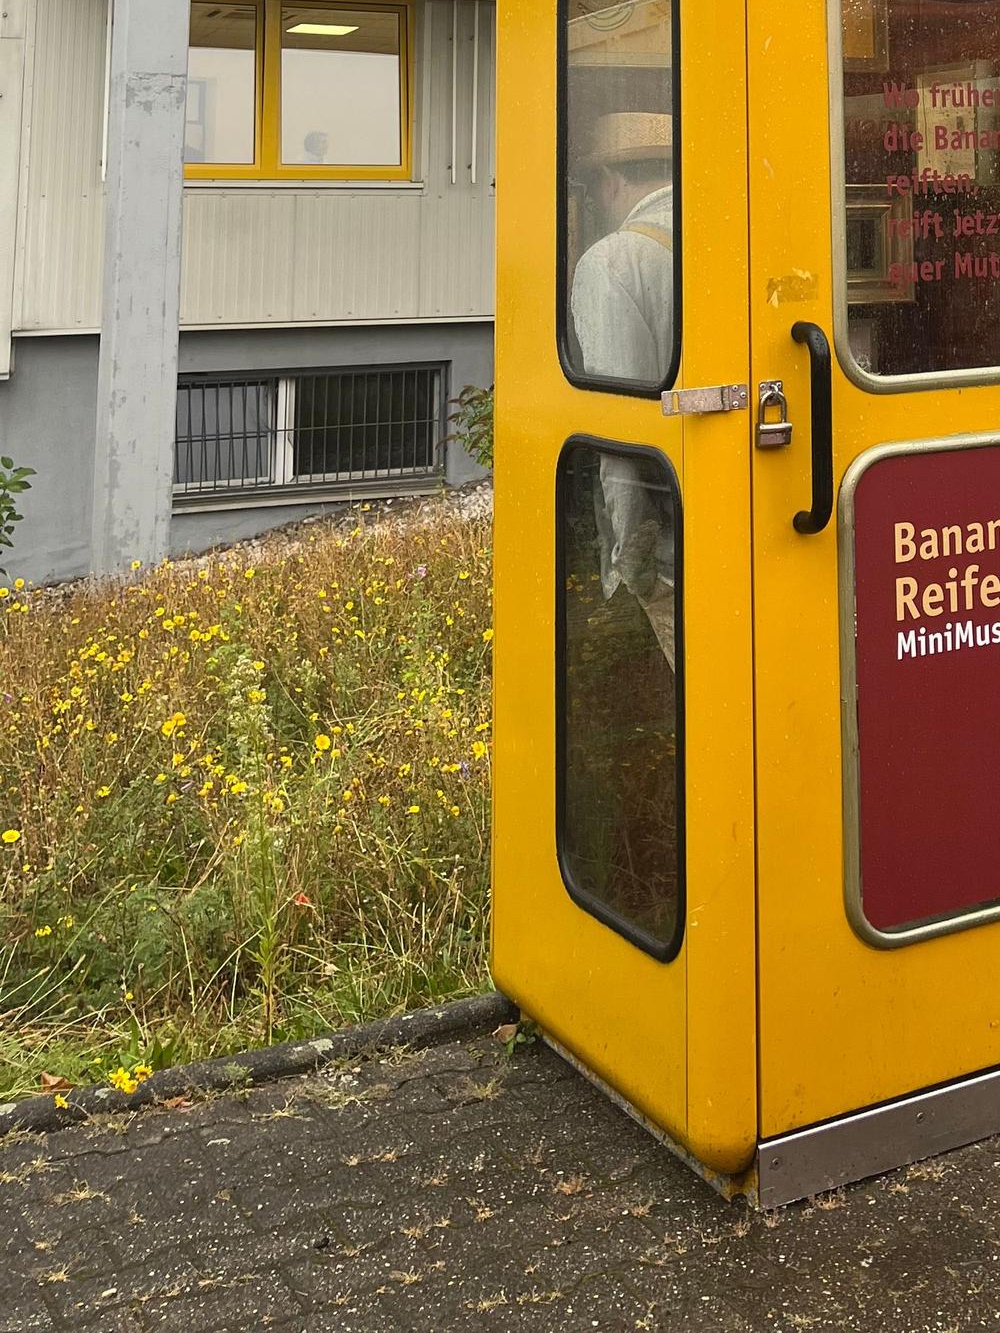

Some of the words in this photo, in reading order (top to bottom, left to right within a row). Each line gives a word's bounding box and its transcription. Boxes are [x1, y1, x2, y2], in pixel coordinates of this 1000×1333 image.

[883, 81, 919, 108] Wo
[884, 123, 924, 151] die
[886, 167, 979, 197] reiften,
[888, 210, 944, 241] reift
